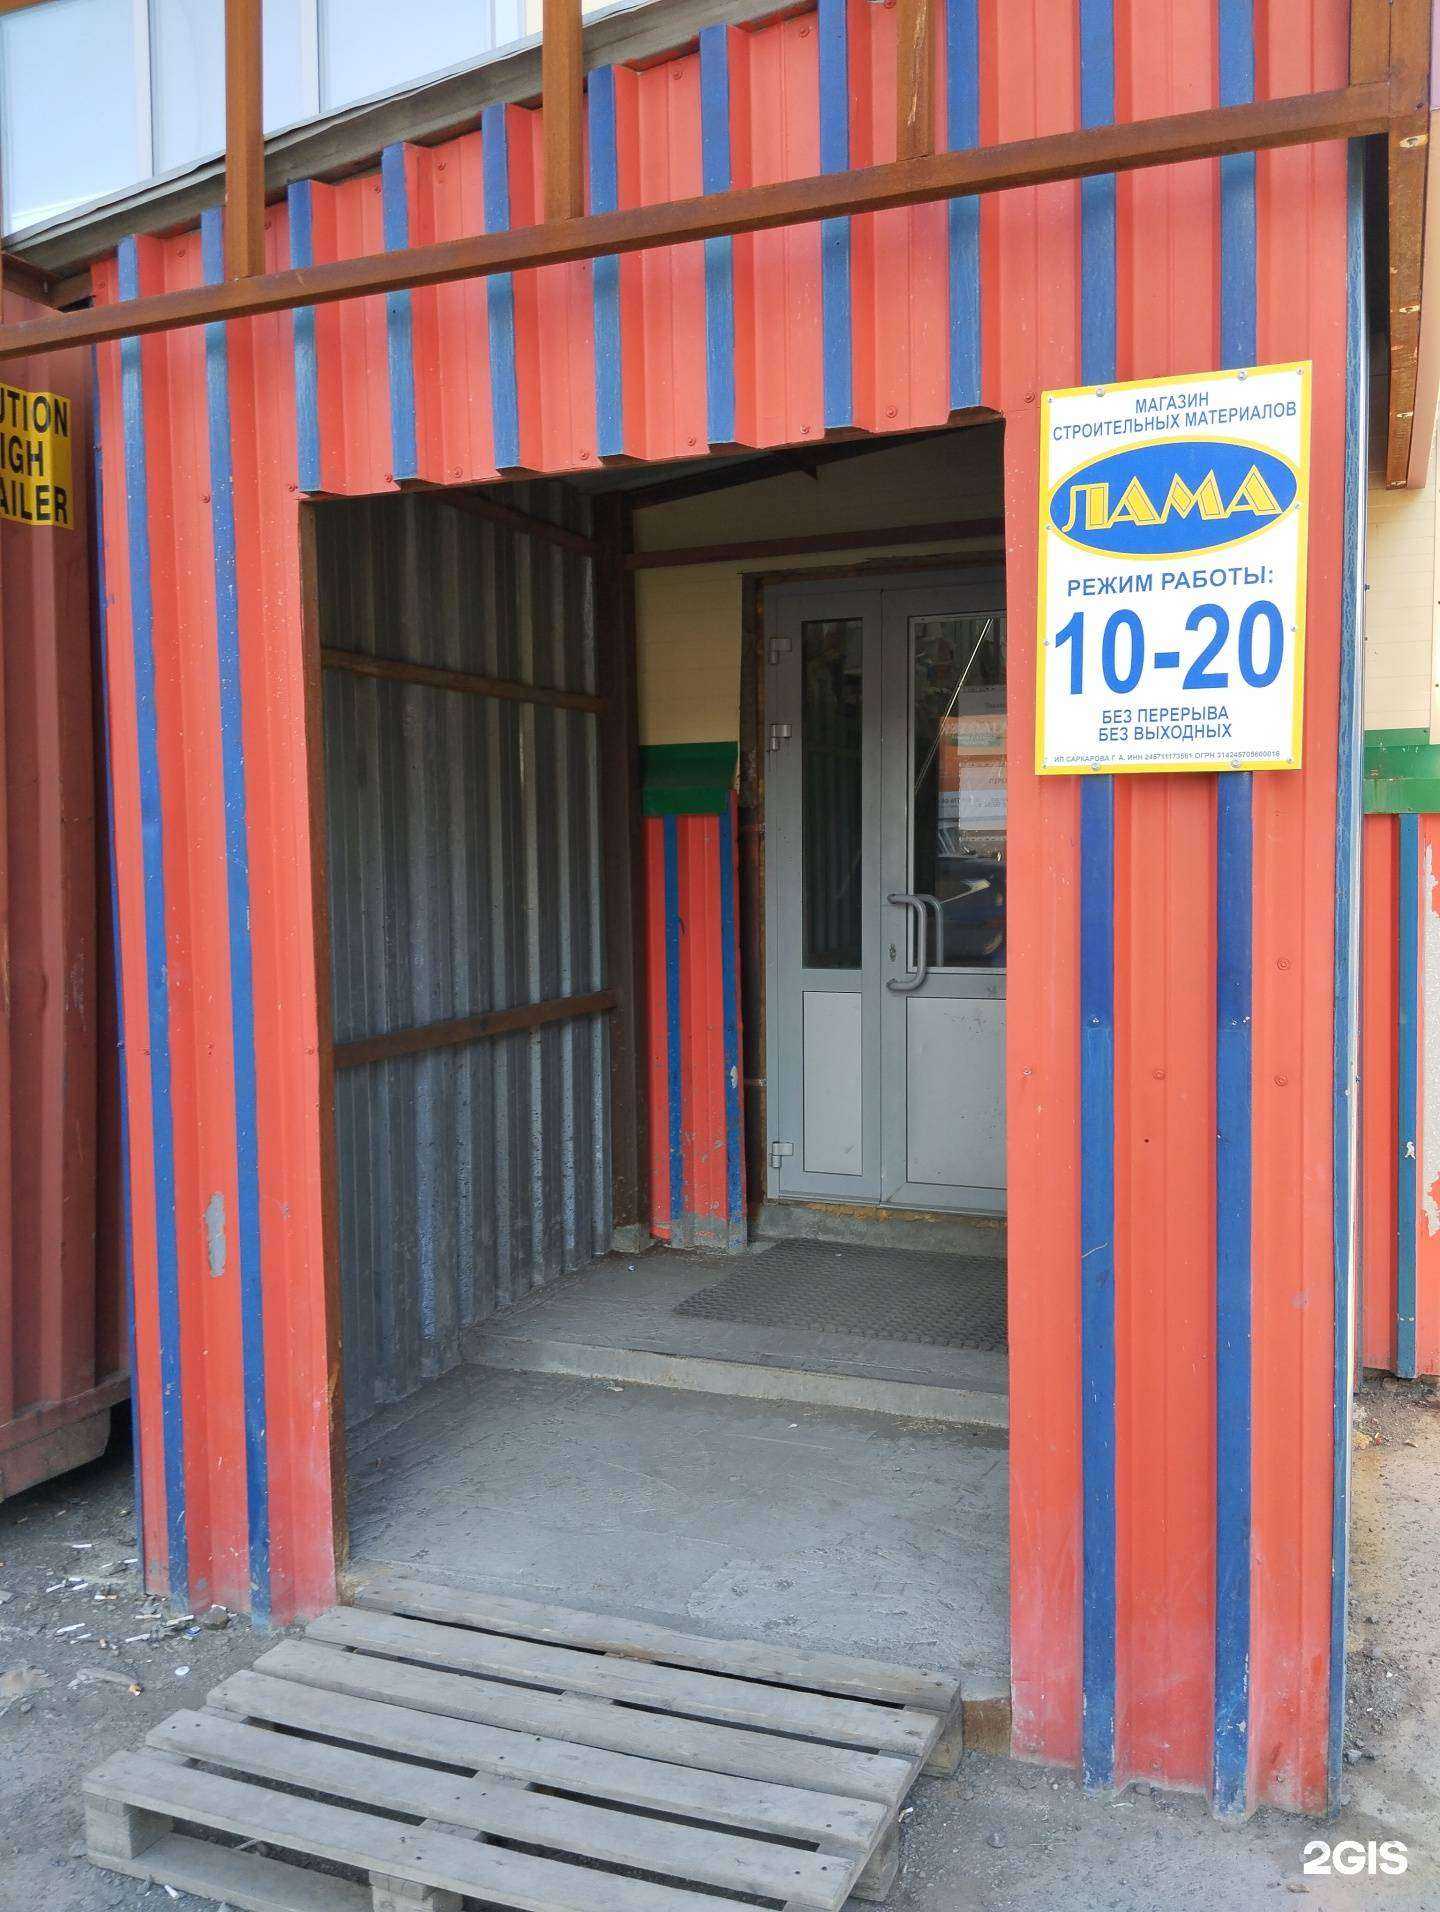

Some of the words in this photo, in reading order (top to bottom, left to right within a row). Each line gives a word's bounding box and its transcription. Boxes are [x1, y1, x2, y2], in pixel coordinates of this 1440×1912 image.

[1135, 392, 1209, 414] МАГАЗИН
[1053, 415, 1180, 441] СТРОИТЕЛЬНЫХ
[1185, 402, 1297, 428] МАТЕРИАЛОВ
[1062, 464, 1284, 532] ЛАМА
[1067, 573, 1153, 596] РЕЖИМ
[1161, 566, 1274, 591] РАБОТЫ:
[1055, 600, 1284, 695] 10-20
[1102, 710, 1133, 724] БЕЗ
[1138, 706, 1229, 723] ПЕРЕРЫВА
[1099, 727, 1128, 742] БЕЗ
[1134, 724, 1232, 741] ВЫХОДНЫХ
